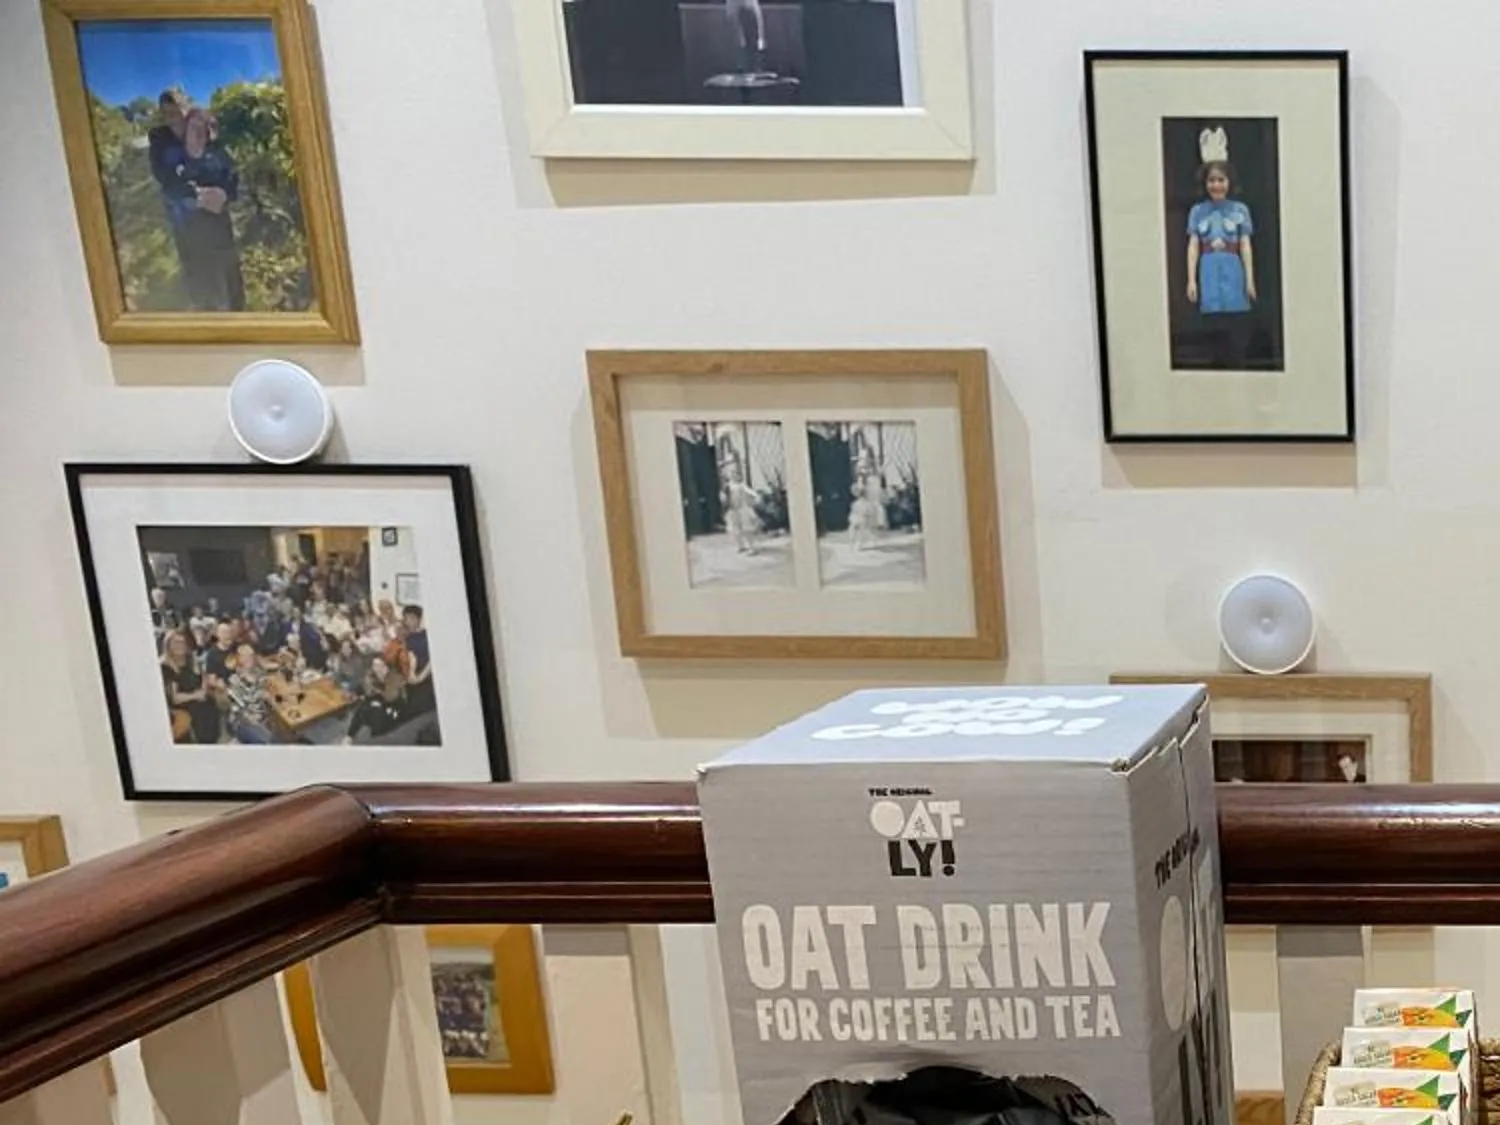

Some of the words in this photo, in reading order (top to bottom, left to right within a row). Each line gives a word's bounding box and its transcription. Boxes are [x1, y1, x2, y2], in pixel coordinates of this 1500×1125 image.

[888, 840, 955, 878] LY!
[741, 904, 877, 991] OAT
[896, 901, 1116, 991] DRINK
[756, 998, 823, 1042] FOR
[830, 997, 957, 1042] COFFEE
[965, 996, 1037, 1041] AND
[1046, 994, 1121, 1039] TEA
